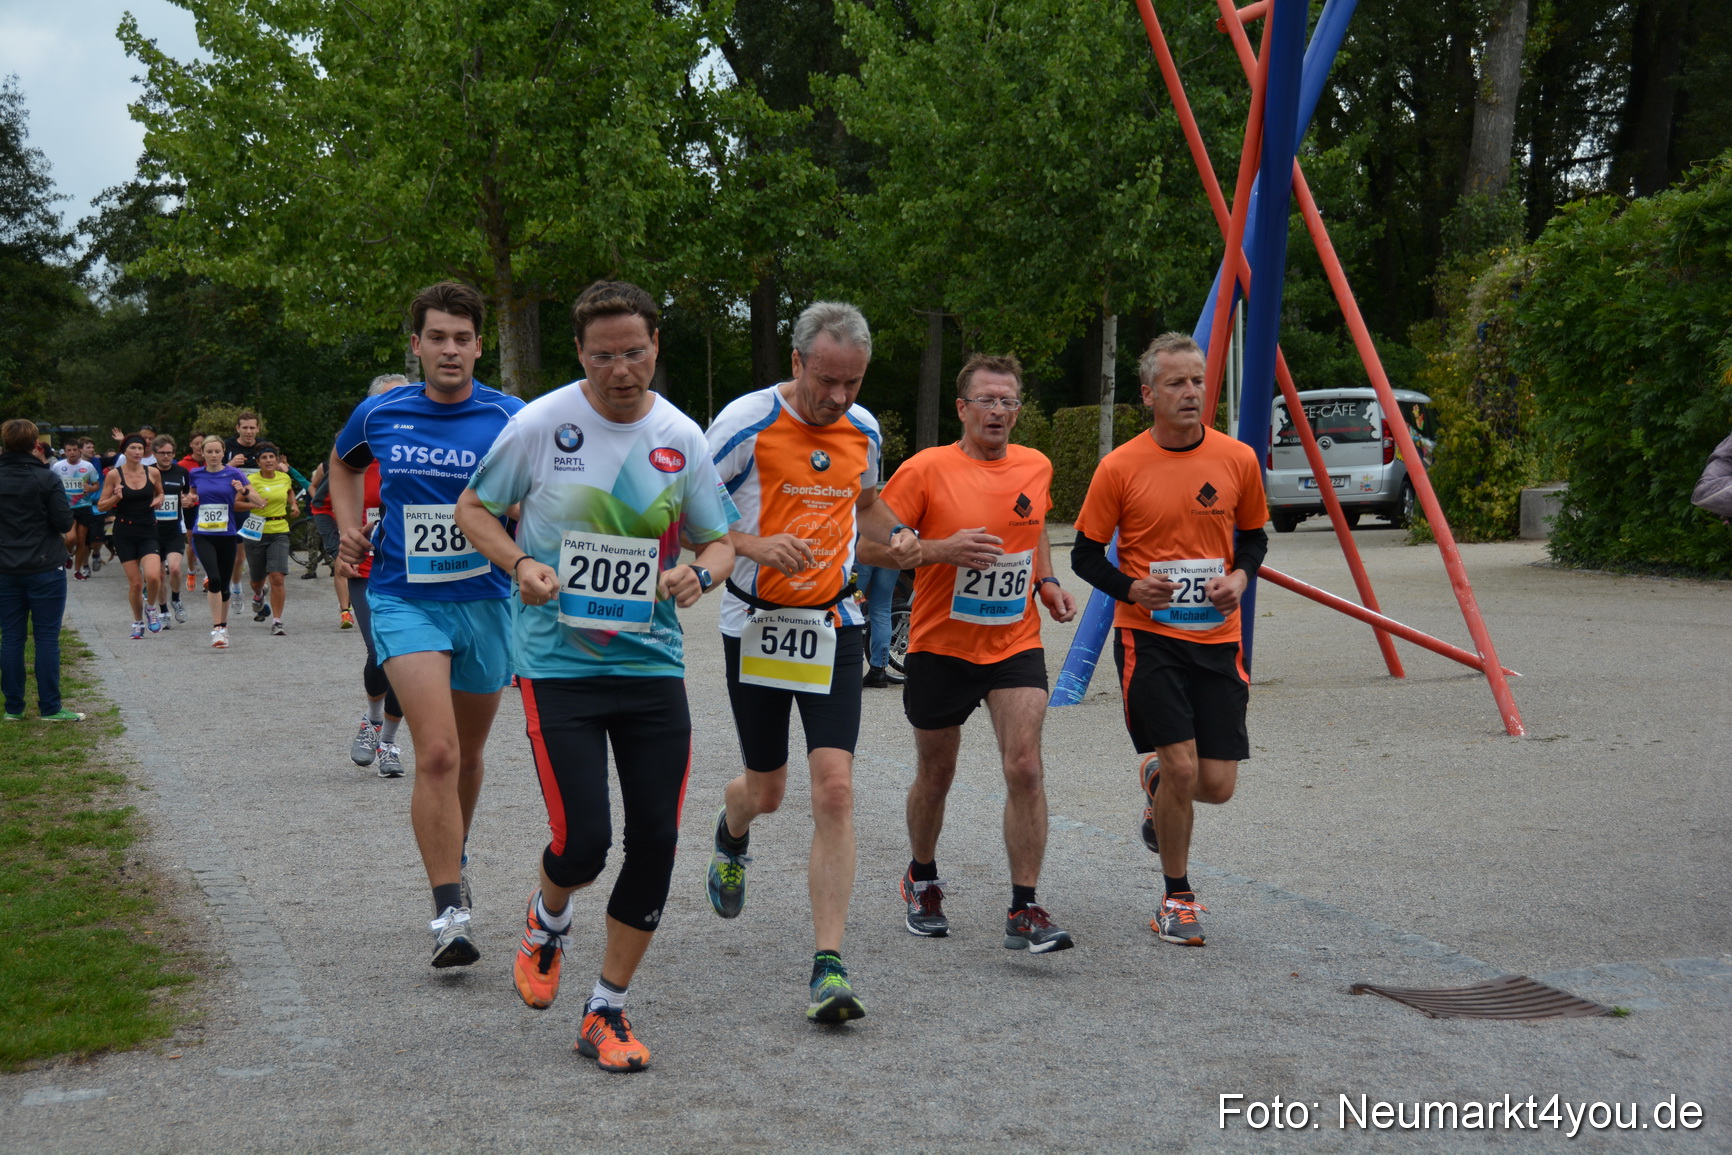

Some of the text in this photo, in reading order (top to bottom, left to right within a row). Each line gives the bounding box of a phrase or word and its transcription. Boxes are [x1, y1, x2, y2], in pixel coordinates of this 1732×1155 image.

[391, 445, 476, 467] SYSCAD
[554, 457, 584, 466] PARTL
[388, 468, 473, 480] www.metallbau-cad.
[65, 481, 82, 489] 3118
[782, 484, 854, 498] SportScheck
[204, 511, 222, 521] 362
[414, 523, 478, 553] 238
[564, 539, 646, 557] PARTL Neumarkt
[430, 560, 468, 571] Fabian
[1181, 566, 1216, 574] Neumarkt
[567, 555, 650, 596] 2082
[963, 569, 1027, 597] 2136
[587, 601, 625, 617] David
[980, 603, 1008, 614] Franz
[777, 616, 821, 626] Neumarkt
[1170, 610, 1209, 621] Michael
[761, 626, 818, 659] 540
